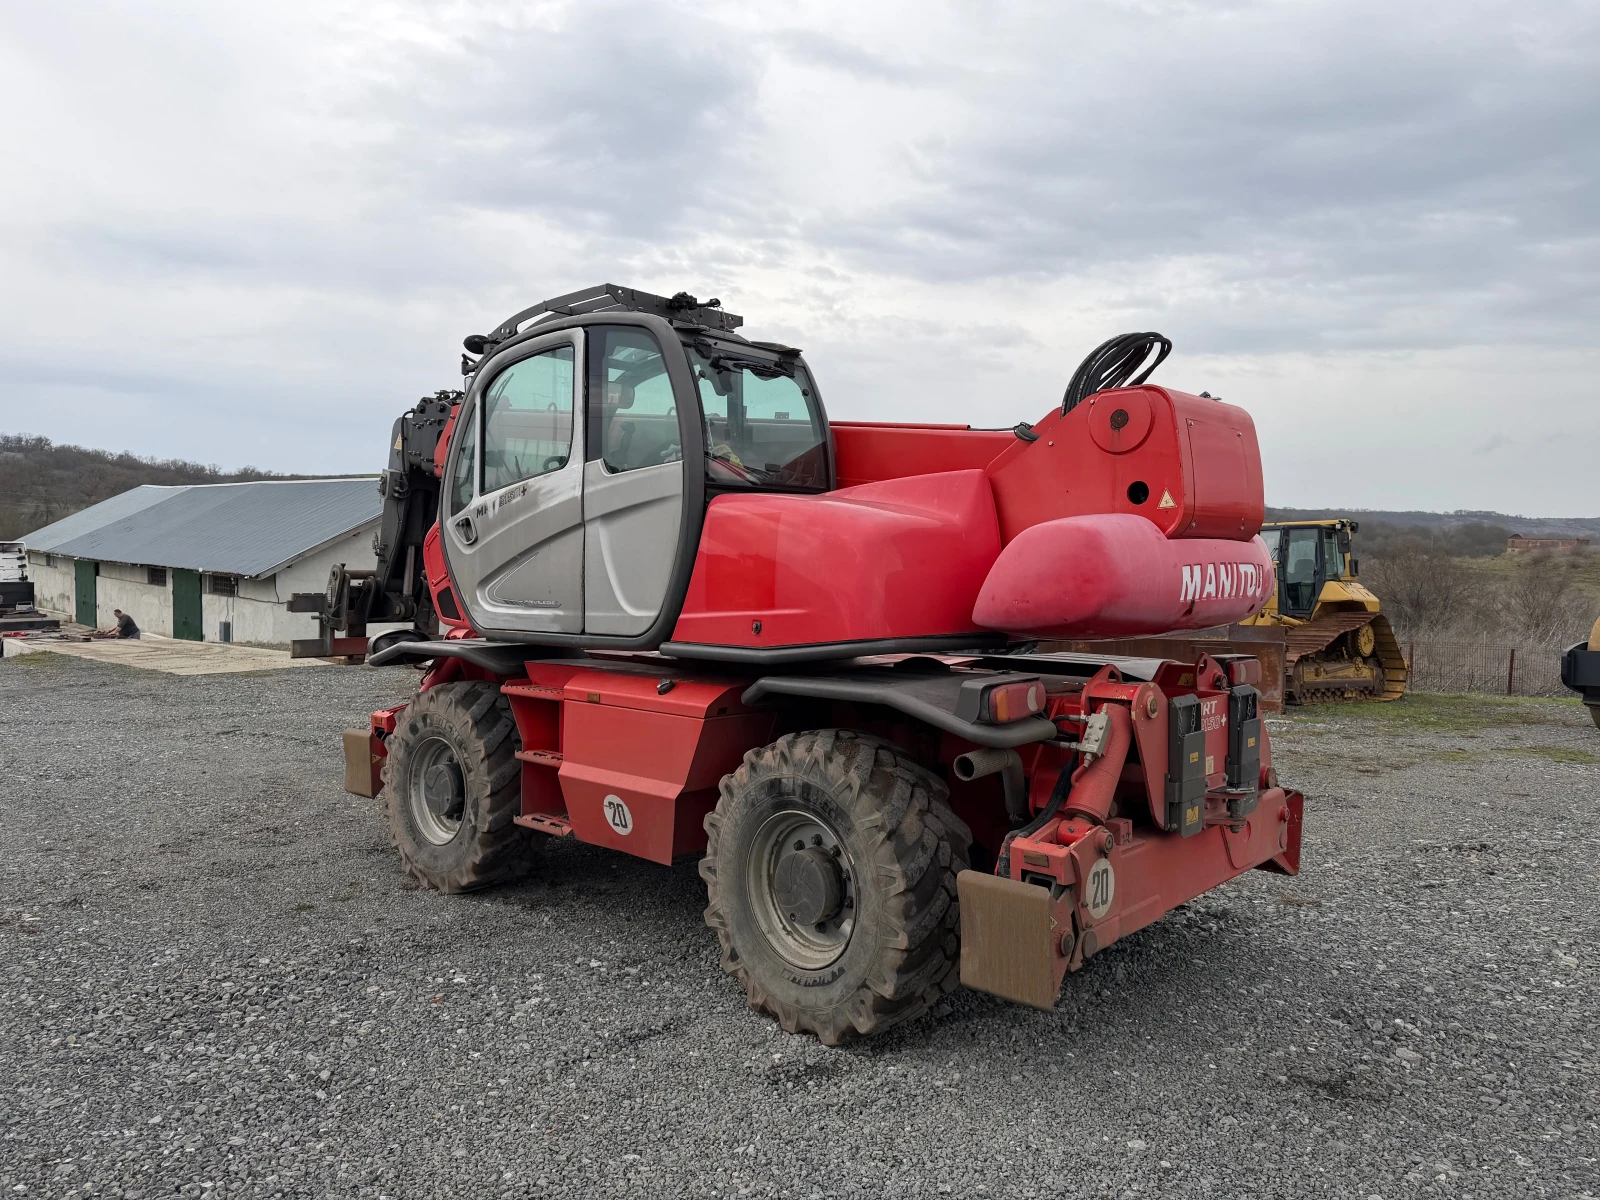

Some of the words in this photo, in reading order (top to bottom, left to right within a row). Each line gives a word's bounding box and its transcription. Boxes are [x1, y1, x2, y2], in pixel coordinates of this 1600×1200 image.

[1180, 562, 1264, 602] MANITOU
[607, 800, 628, 829] 20
[1092, 867, 1109, 910] 20
